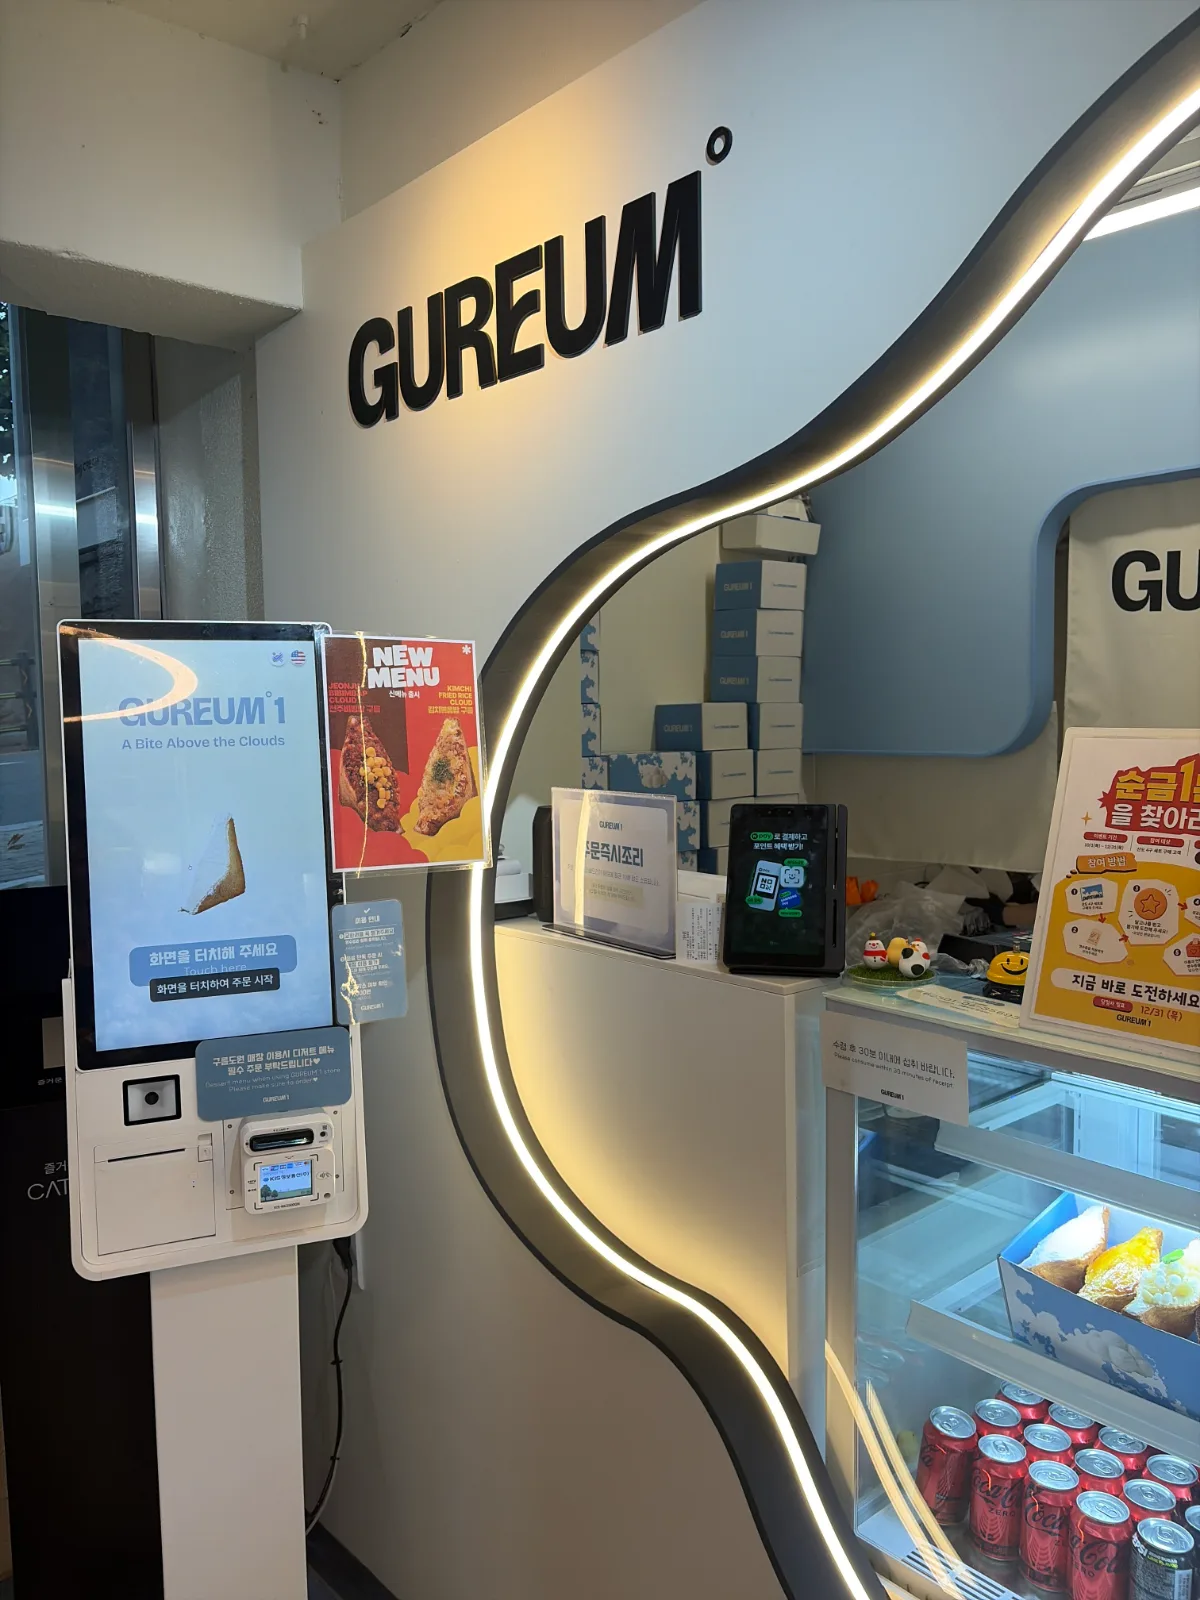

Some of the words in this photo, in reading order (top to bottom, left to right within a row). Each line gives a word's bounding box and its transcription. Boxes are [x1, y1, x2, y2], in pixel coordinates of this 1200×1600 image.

[372, 645, 433, 667] NEW
[367, 667, 440, 689] MENU
[388, 690, 406, 698] 신메뉴
[408, 690, 420, 699] 출시
[438, 691, 457, 699] FRIED
[121, 739, 132, 750] A
[135, 738, 163, 749] Bite
[167, 737, 209, 749] Above
[213, 736, 235, 747] the
[239, 735, 285, 747] Clouds
[1111, 803, 1133, 826] 을
[1087, 857, 1106, 868] 참여
[1107, 856, 1126, 867] 방법
[149, 949, 190, 967] 화면을
[194, 945, 235, 962] 터치해
[239, 942, 278, 958] 주세요
[156, 982, 187, 995] 화면을
[190, 978, 229, 992] 터치하여
[232, 976, 252, 988] 주문
[254, 974, 273, 986] 시작
[1072, 973, 1096, 991] 지금
[1101, 978, 1126, 995] 바로
[1131, 983, 1200, 1008] 도전하세요
[1140, 1005, 1163, 1018] 12/31
[212, 1055, 245, 1066] 구름도원
[247, 1052, 264, 1063] 매장
[266, 1050, 290, 1061] 이용시
[293, 1047, 317, 1058] 디저트
[318, 1045, 335, 1055] 메뉴
[858, 1046, 877, 1059] 30분
[878, 1050, 901, 1065] 이내에
[902, 1057, 918, 1070] 섭취
[920, 1061, 955, 1079] 바랍니다.
[227, 1065, 244, 1077] 필수
[246, 1063, 263, 1074] 주문
[834, 1051, 850, 1061] Please
[851, 1058, 875, 1068] consume
[875, 1063, 892, 1072] within
[893, 1067, 901, 1075] 30
[901, 1070, 924, 1081] minutes
[228, 1083, 250, 1093] Please
[252, 1081, 270, 1090] make
[270, 1080, 287, 1088] sure
[252, 1075, 271, 1083] when
[271, 1073, 290, 1081] using
[988, 1508, 1016, 1517] ZERO
